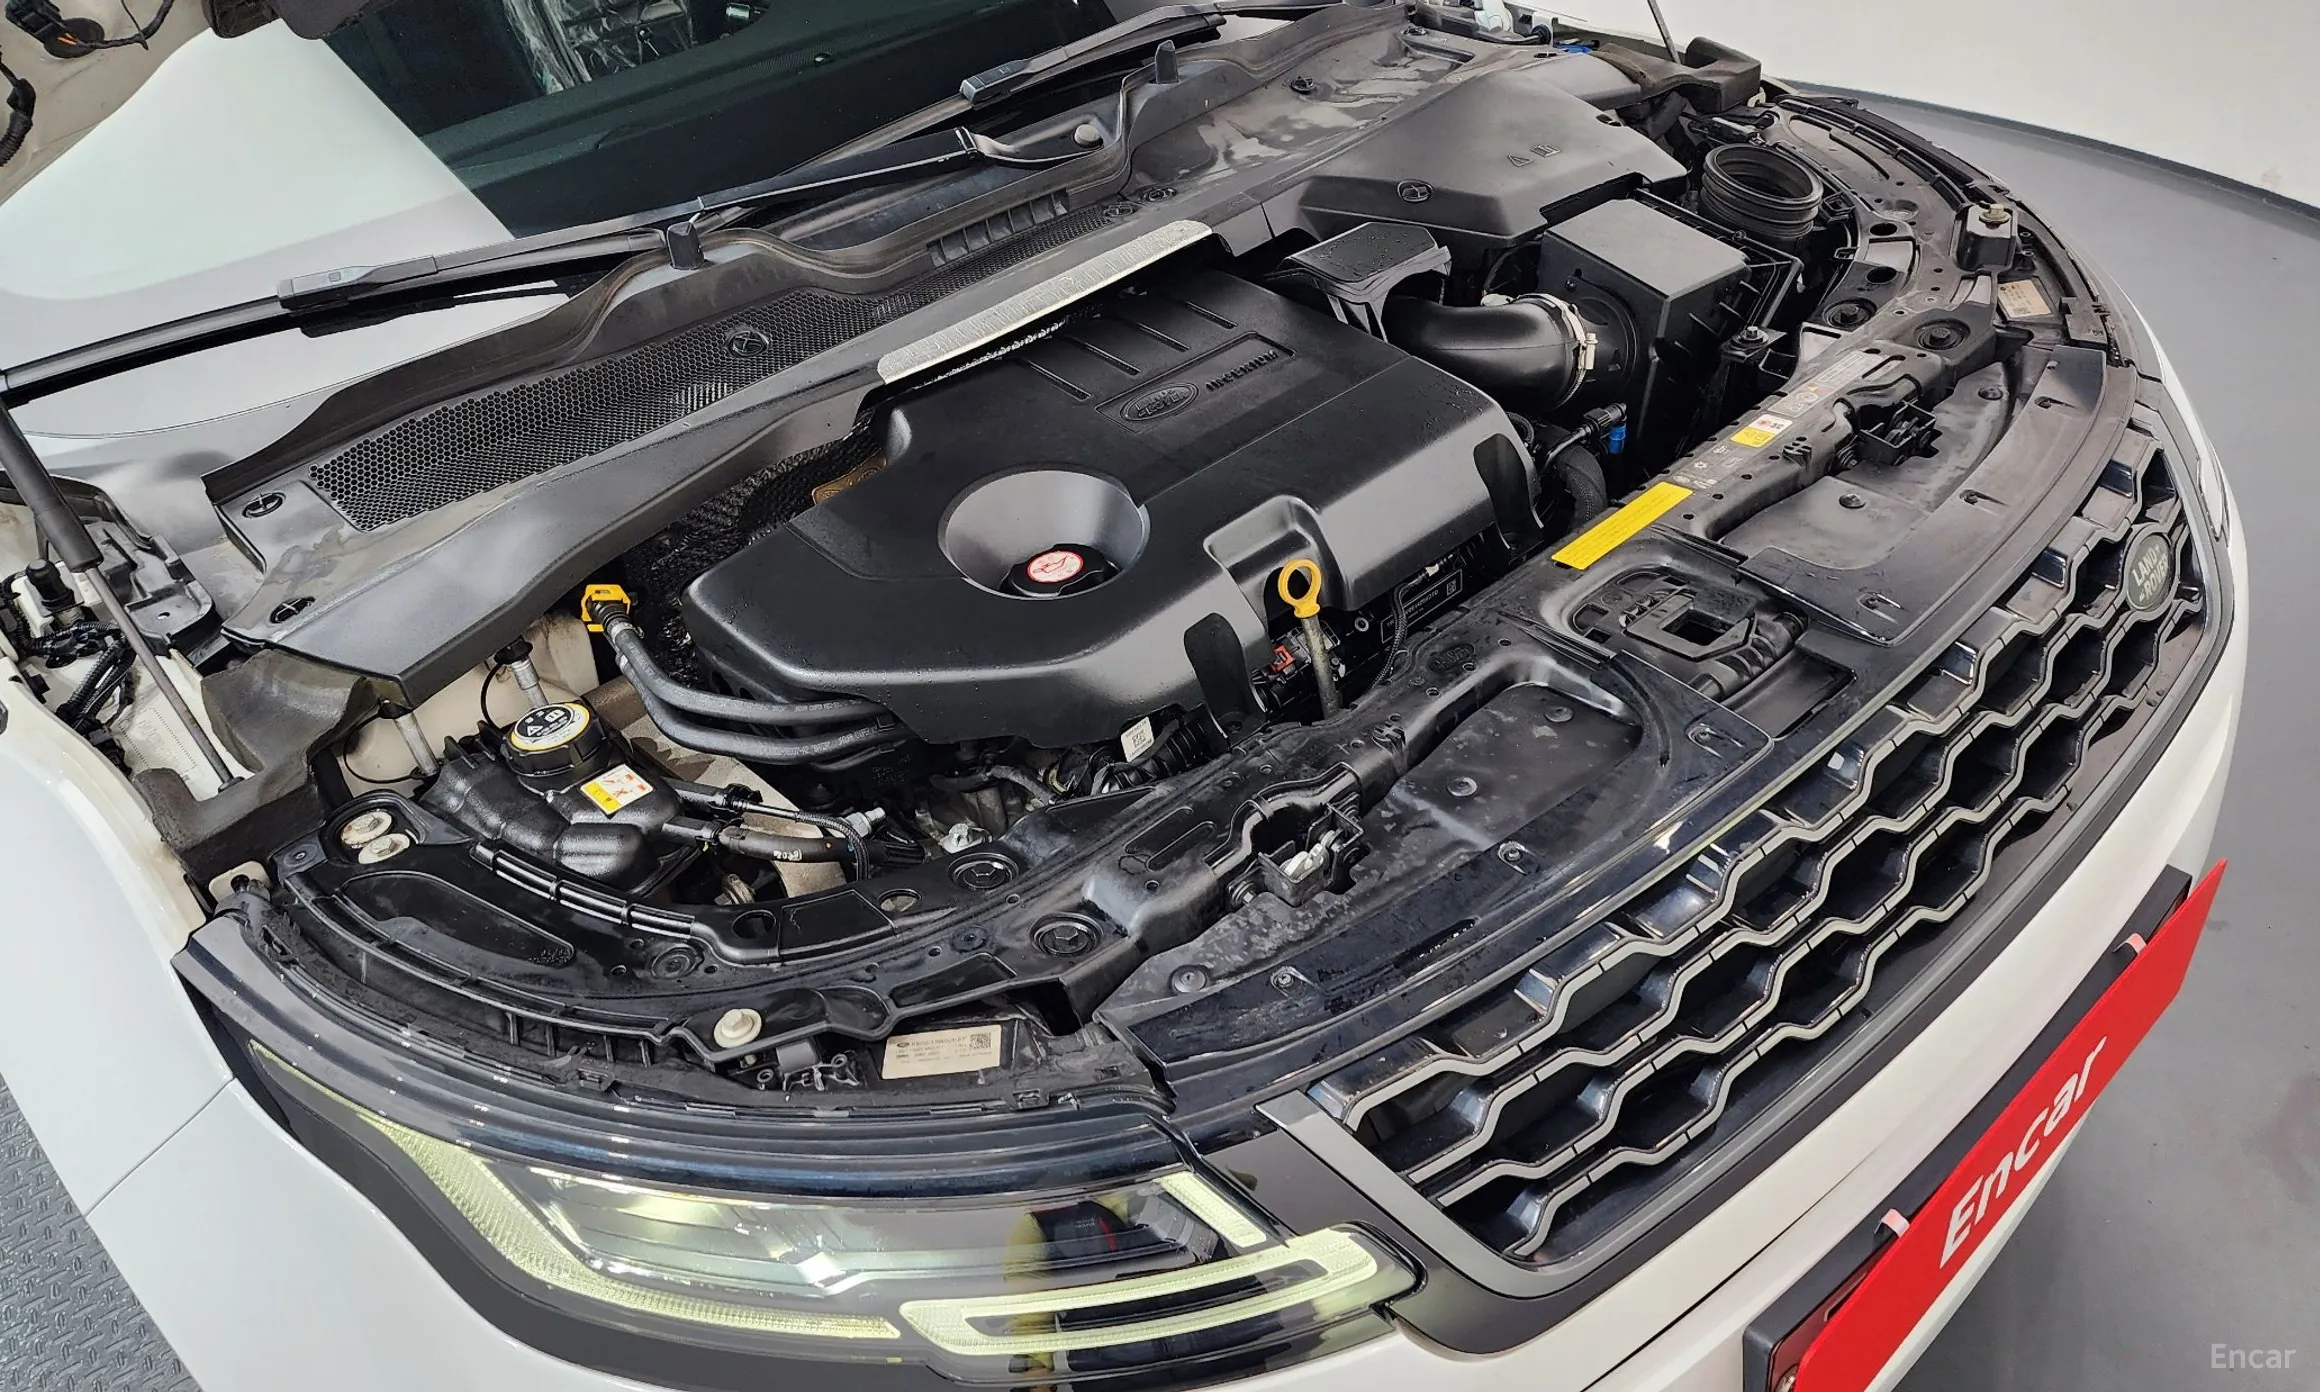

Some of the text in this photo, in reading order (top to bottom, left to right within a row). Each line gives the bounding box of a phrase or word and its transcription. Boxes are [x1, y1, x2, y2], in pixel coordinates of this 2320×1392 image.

[2132, 547, 2158, 587] LAND
[2143, 553, 2169, 599] ROVER
[1939, 1035, 2108, 1269] Encar
